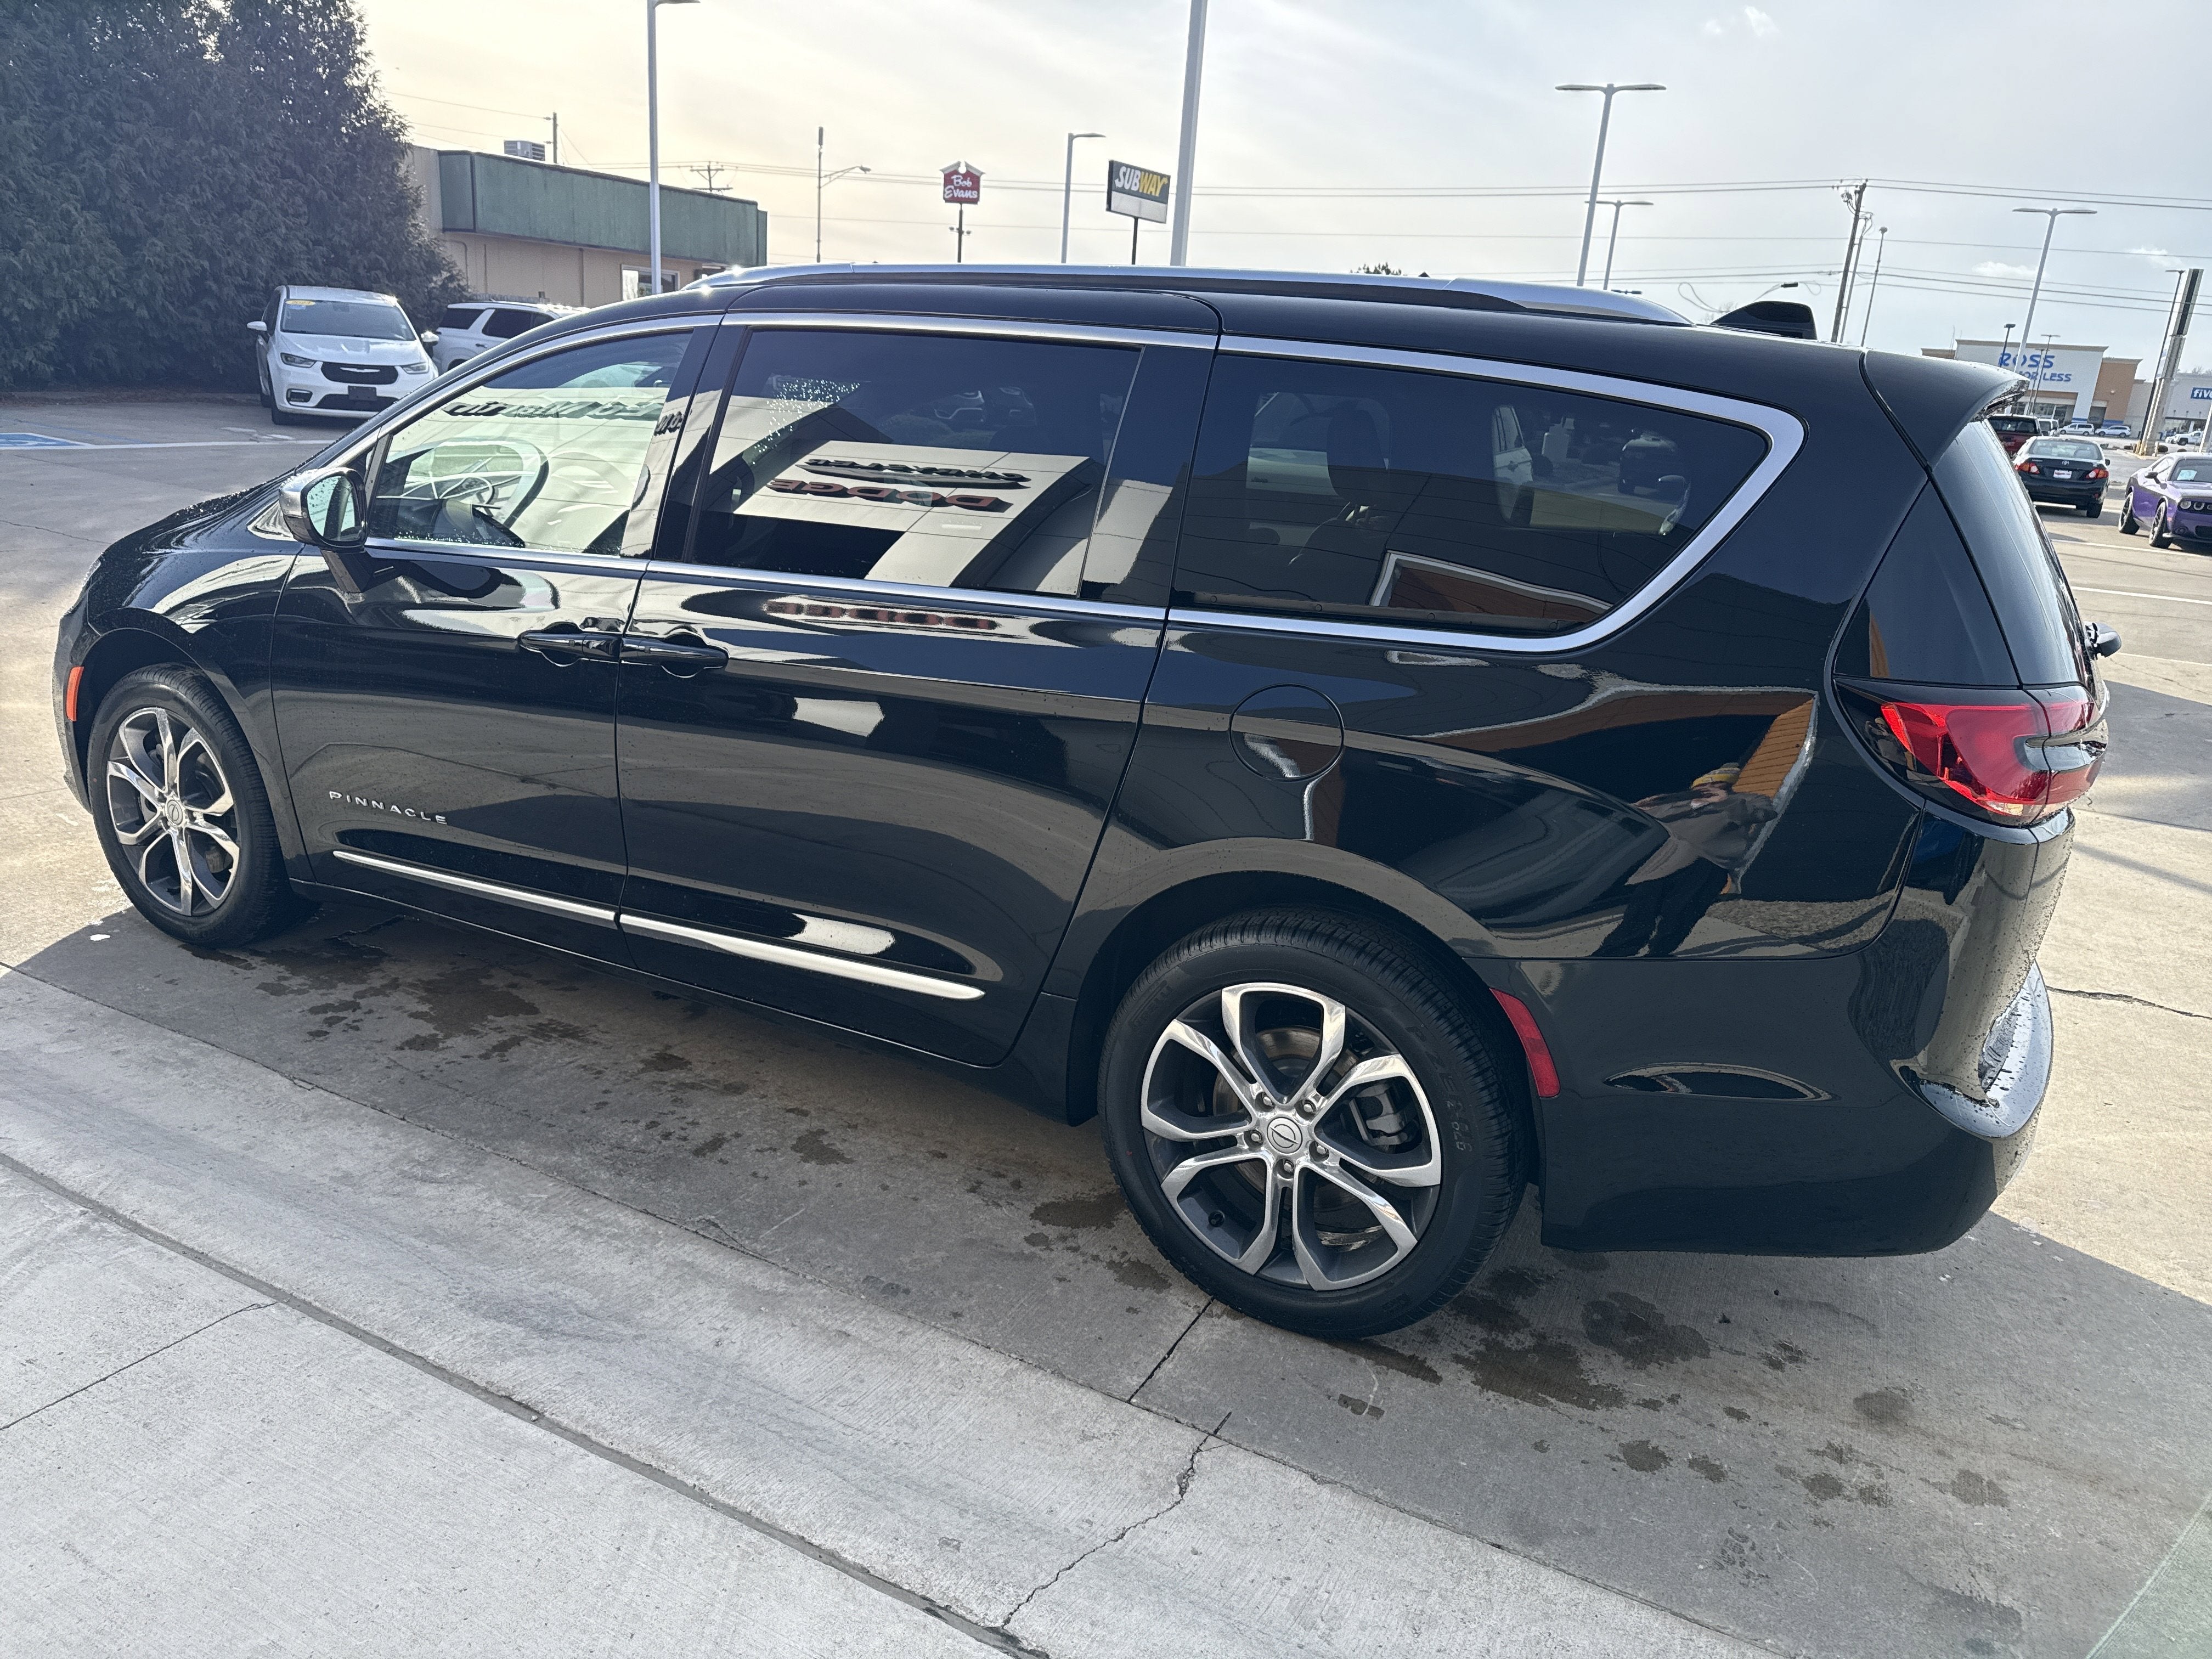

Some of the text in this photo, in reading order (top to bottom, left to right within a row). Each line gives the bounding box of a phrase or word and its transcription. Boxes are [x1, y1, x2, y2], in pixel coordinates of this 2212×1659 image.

[951, 174, 973, 187] Bob
[1114, 166, 1168, 197] SUBWAY
[944, 185, 978, 199] Evans
[1998, 352, 2055, 368] ROSS
[2042, 373, 2072, 382] LESS
[329, 791, 448, 825] PINNACLE
